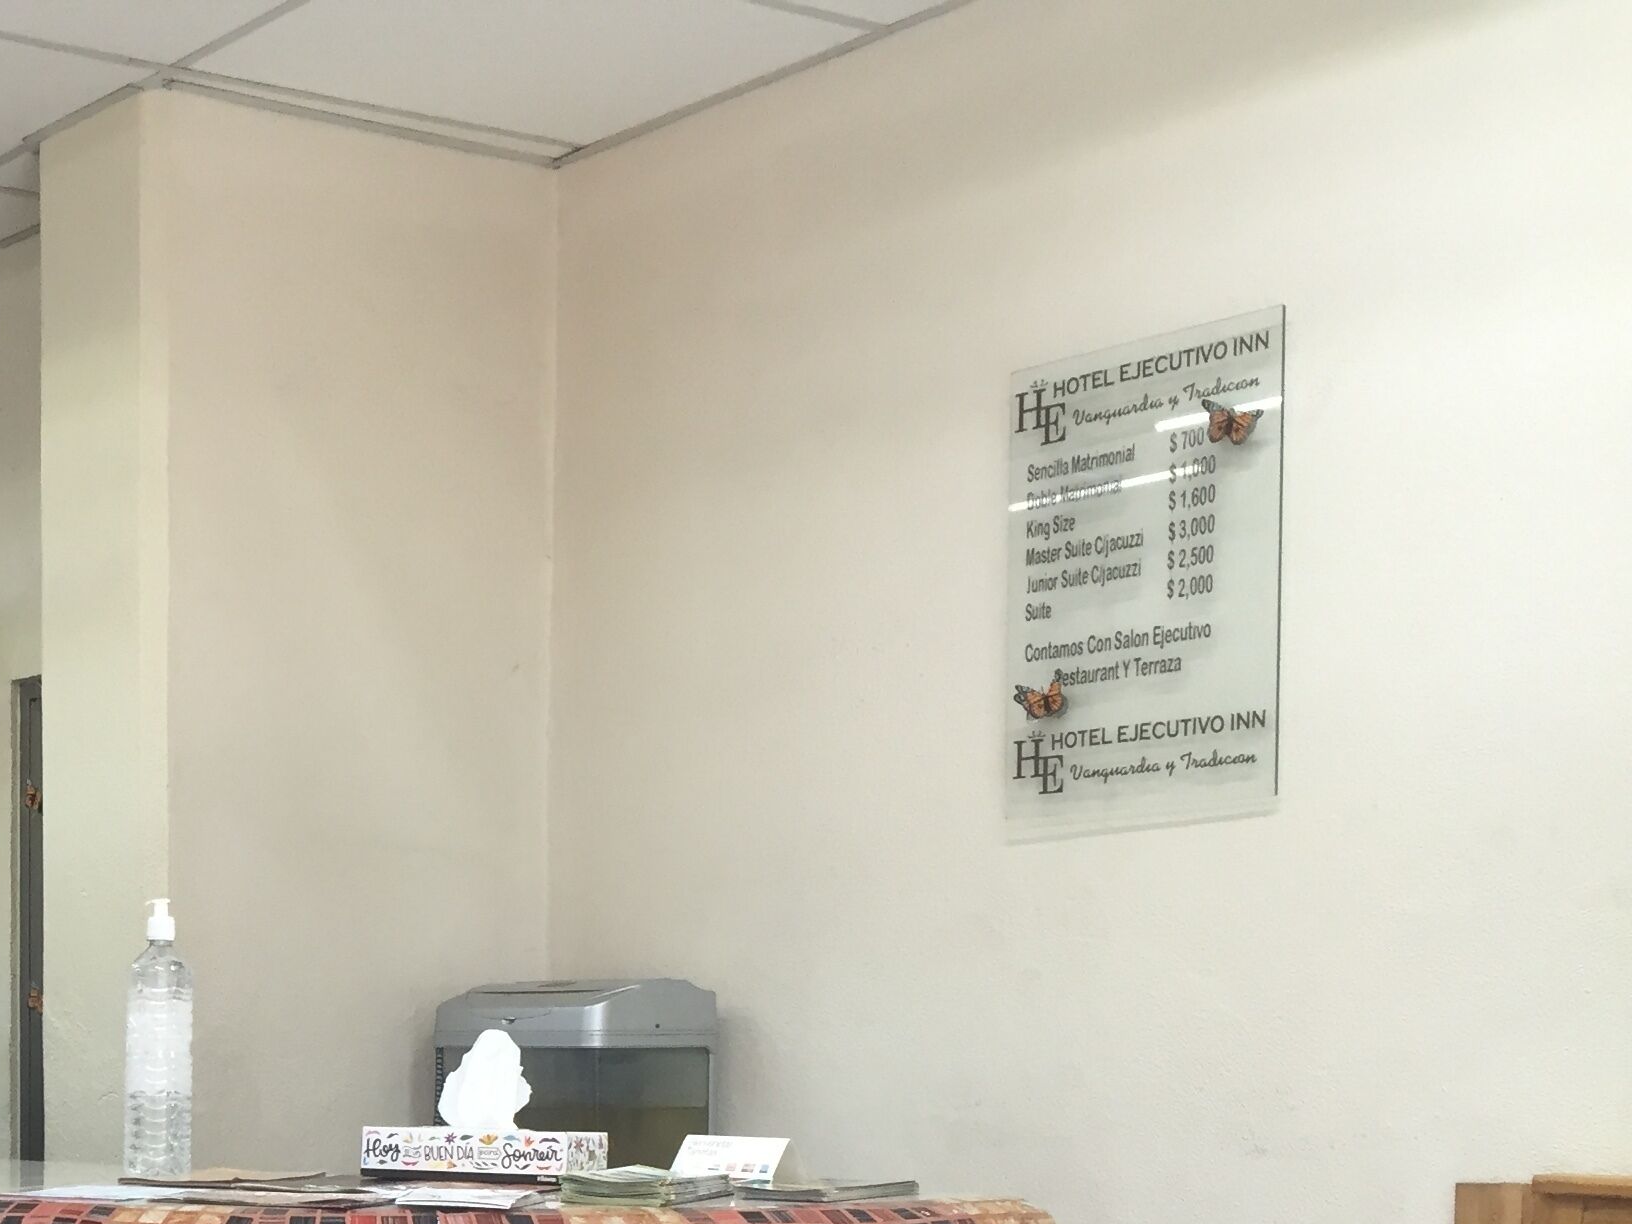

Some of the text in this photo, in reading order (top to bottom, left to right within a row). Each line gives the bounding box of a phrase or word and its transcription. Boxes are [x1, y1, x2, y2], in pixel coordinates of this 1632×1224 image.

[1053, 330, 1270, 398] HOTEL EJECUTIVO INN
[1073, 394, 1164, 426] Vanguardia
[1168, 392, 1179, 407] y
[1027, 463, 1069, 482] Sencilla
[1071, 443, 1135, 474] Matrimonial
[1181, 427, 1205, 450] 700
[1026, 547, 1062, 567] Master
[1065, 538, 1092, 560] Suite
[1179, 514, 1215, 541] 3,000
[1027, 520, 1050, 541] King
[1053, 515, 1076, 534] Size
[1027, 572, 1058, 594] Junior
[1061, 568, 1089, 588] Suite
[1178, 544, 1214, 570] 2,500
[1025, 602, 1052, 621] Suite
[1178, 574, 1213, 600] 2,000
[1025, 621, 1212, 662] Contamos Con Salon Ejecutivo
[1122, 659, 1131, 678] Y
[1134, 655, 1182, 677] Terraza
[1051, 709, 1267, 751] HOTEL EJECUTIVO INN
[1070, 757, 1161, 784] Vanguardia
[1166, 760, 1176, 776] y
[364, 1138, 401, 1162] Hoy
[424, 1145, 454, 1161] BUEN
